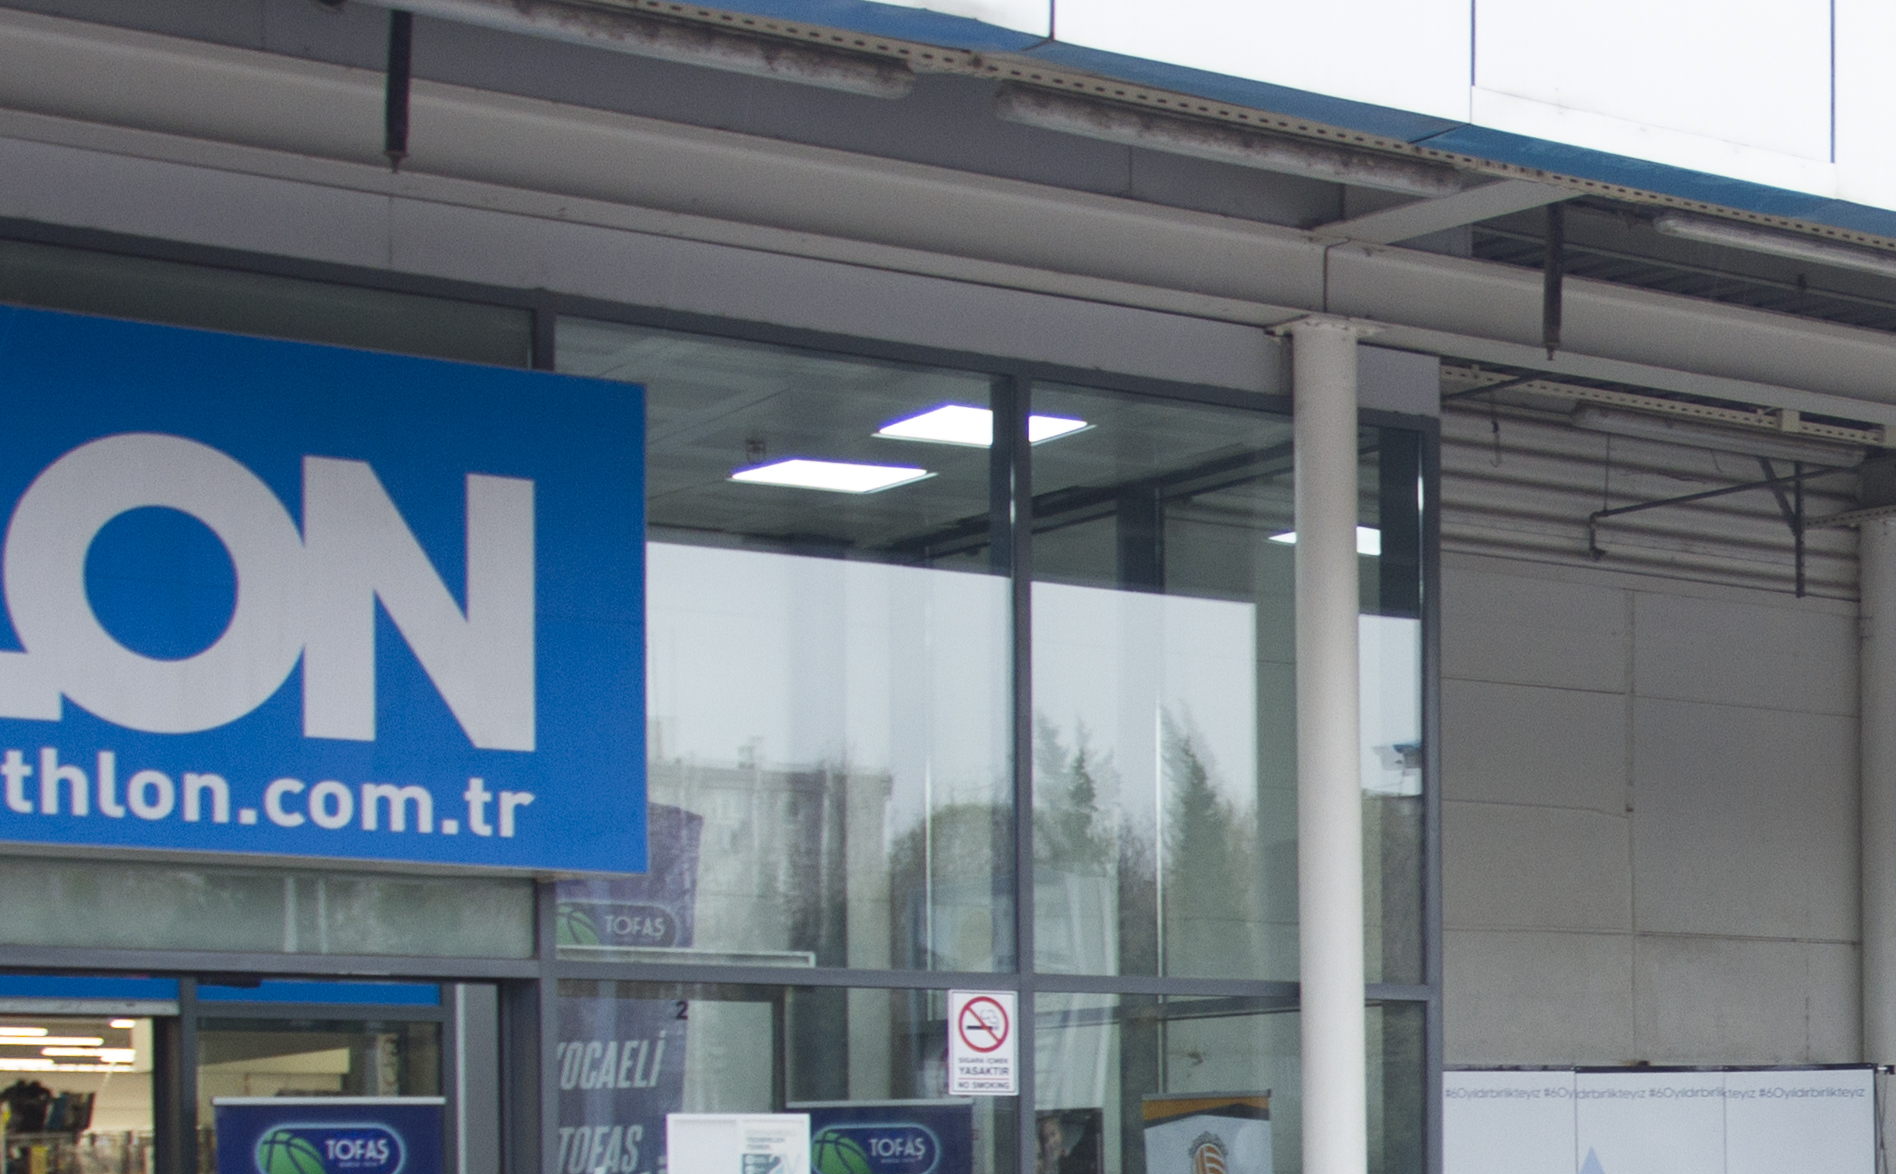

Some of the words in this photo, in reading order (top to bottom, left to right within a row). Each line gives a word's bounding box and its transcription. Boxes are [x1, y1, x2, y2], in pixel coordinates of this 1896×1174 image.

[0, 431, 535, 752] ON
[676, 1000, 689, 1020] 2
[556, 1028, 667, 1091] OCAELİ
[959, 1066, 1010, 1075] YASAKTIR
[958, 1081, 970, 1089] NO
[325, 1138, 390, 1164] TOFAŞ
[868, 1137, 927, 1161] TOFAŞ
